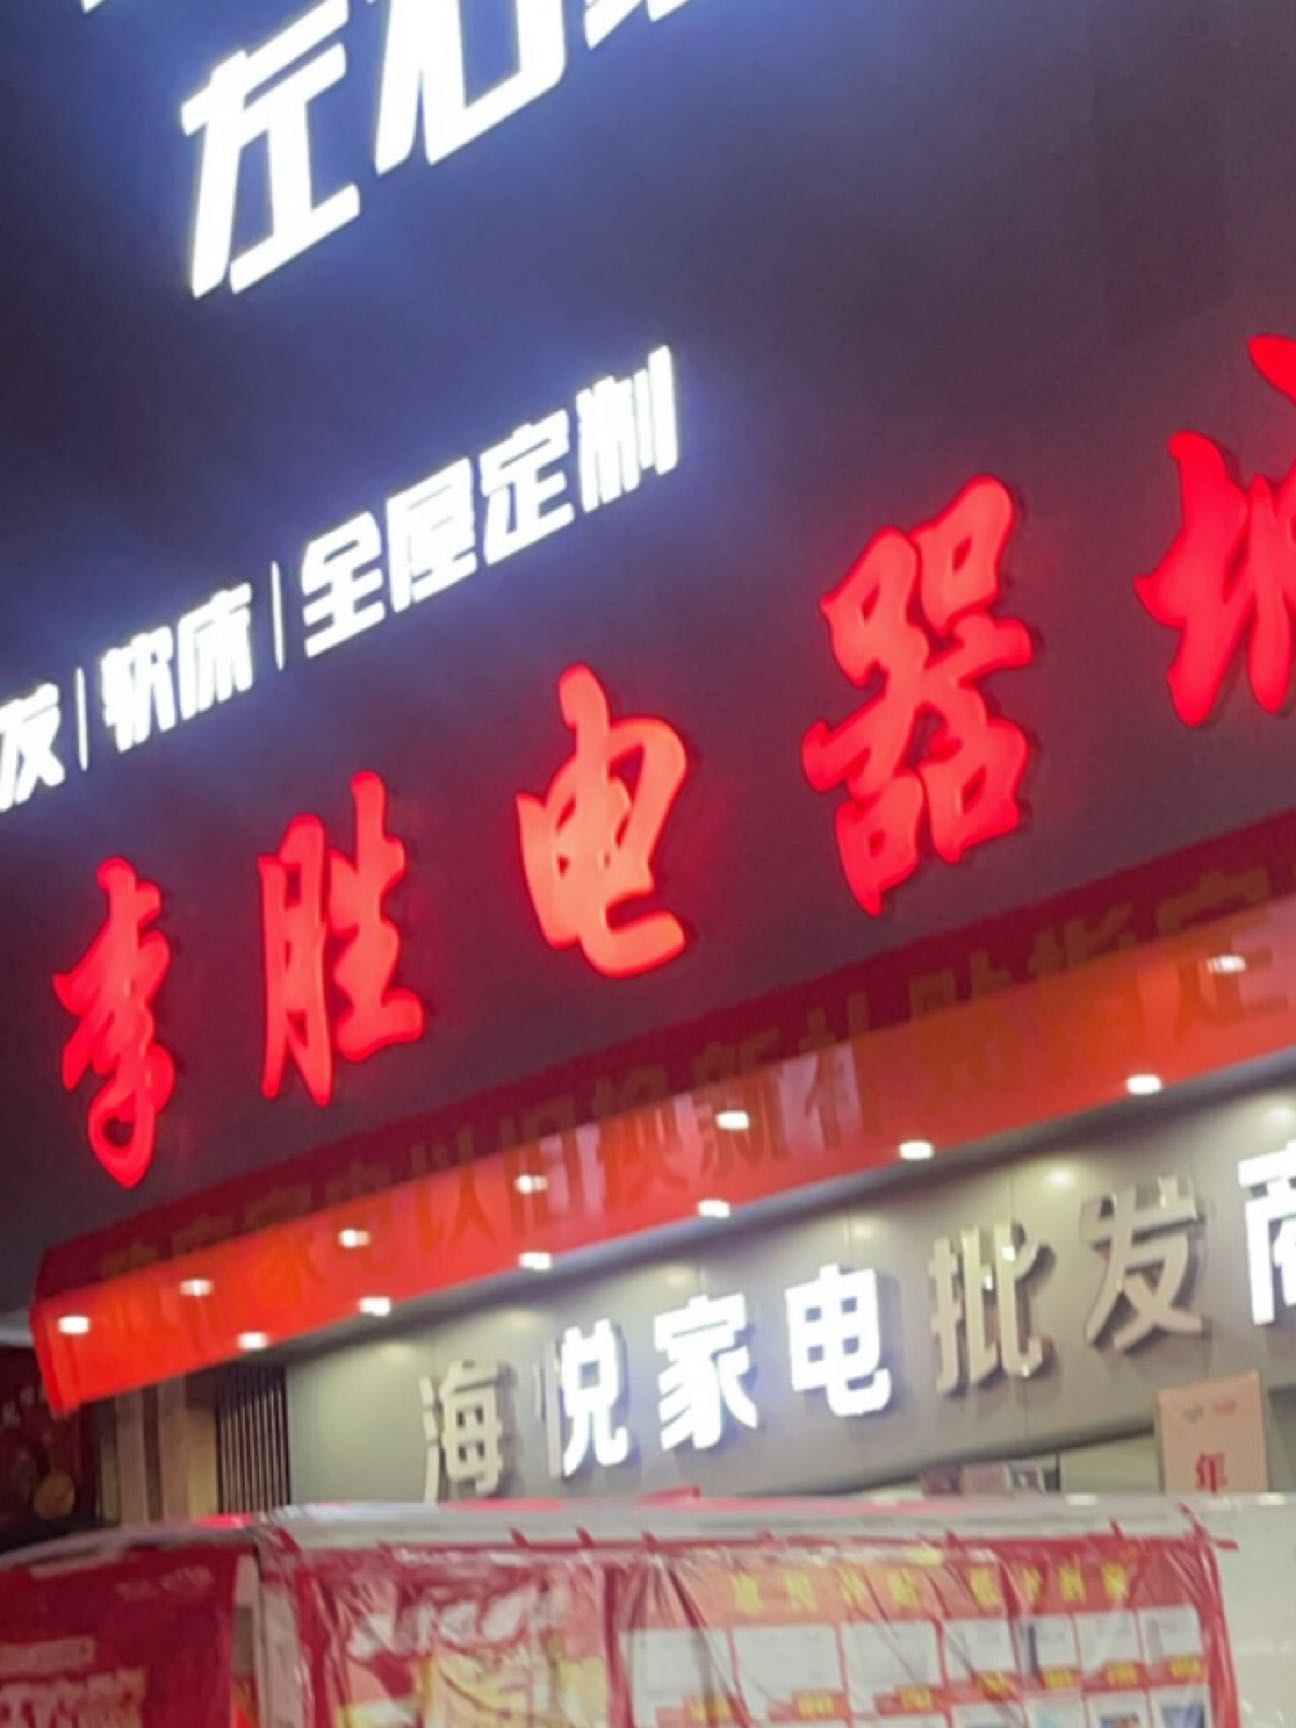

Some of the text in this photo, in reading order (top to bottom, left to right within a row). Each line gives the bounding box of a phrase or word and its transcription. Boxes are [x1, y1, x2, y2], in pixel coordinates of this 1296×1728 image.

[180, 0, 700, 298] 左右
[100, 582, 253, 753] 软床
[301, 345, 678, 659] 全屋定制
